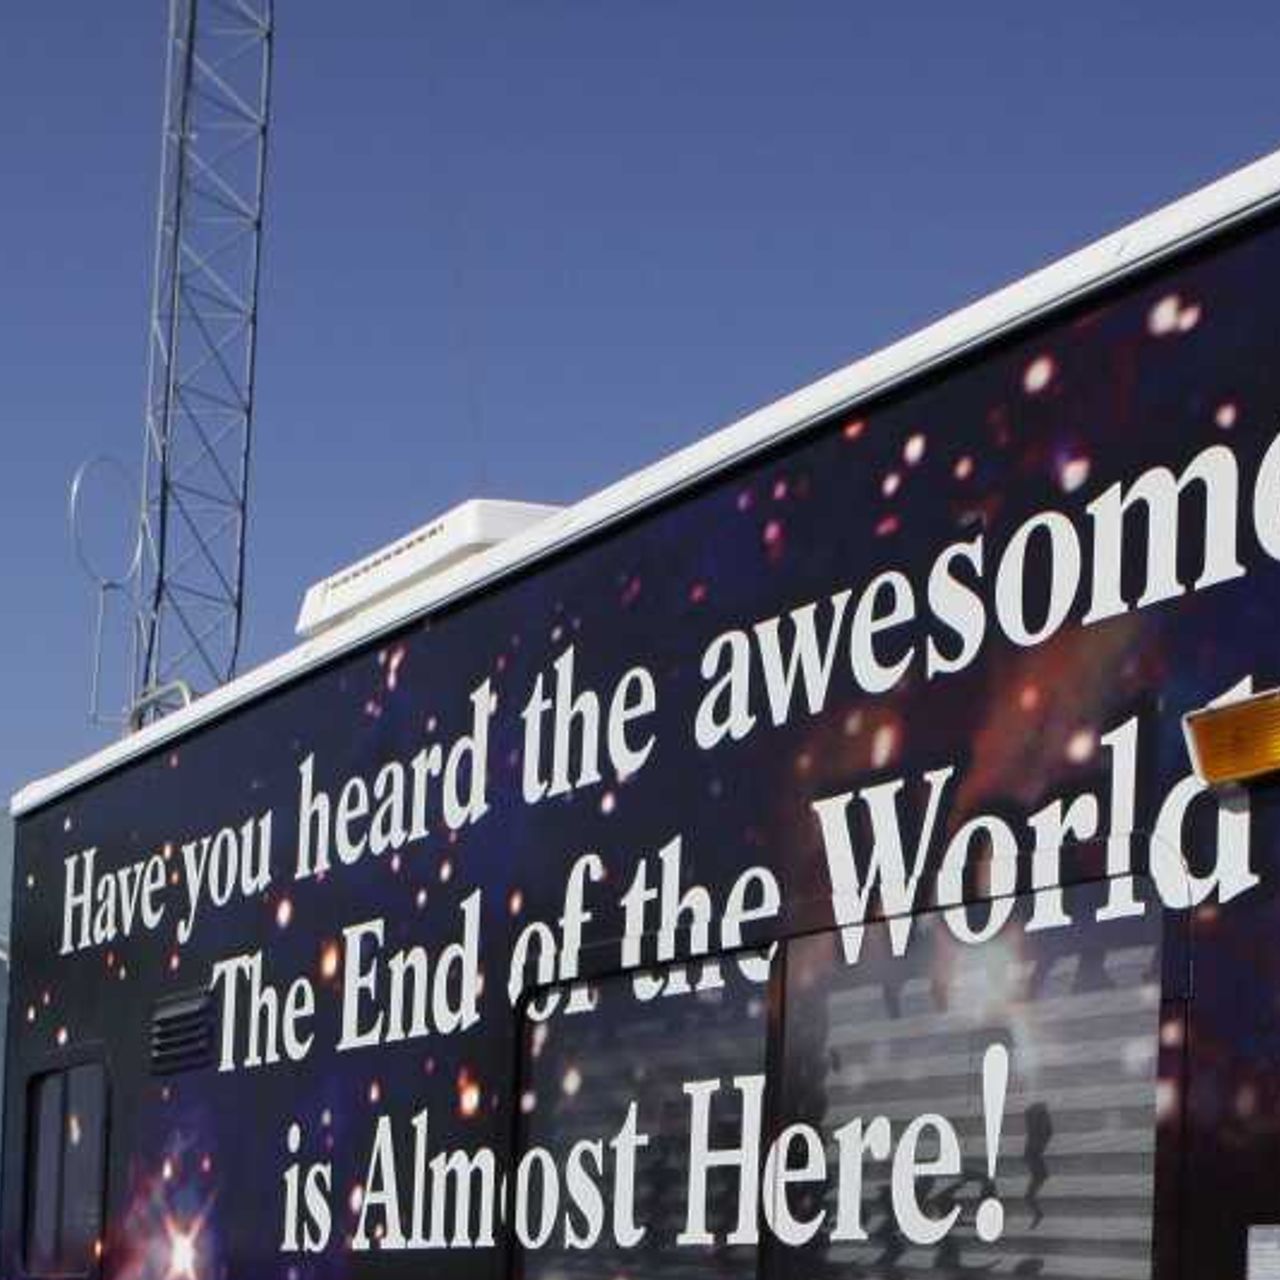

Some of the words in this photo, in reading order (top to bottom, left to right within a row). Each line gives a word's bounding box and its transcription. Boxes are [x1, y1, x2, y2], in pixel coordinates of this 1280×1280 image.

[60, 847, 167, 954] Have
[177, 809, 272, 943] you
[295, 679, 492, 876] heard
[522, 645, 657, 808] the
[211, 950, 314, 1072] The
[336, 890, 484, 1052] End
[508, 854, 604, 1022] of
[620, 834, 780, 1001] the
[810, 675, 1260, 966] World
[281, 1123, 332, 1253] is
[351, 1099, 650, 1251] Almost
[677, 1042, 1009, 1246] Here!
